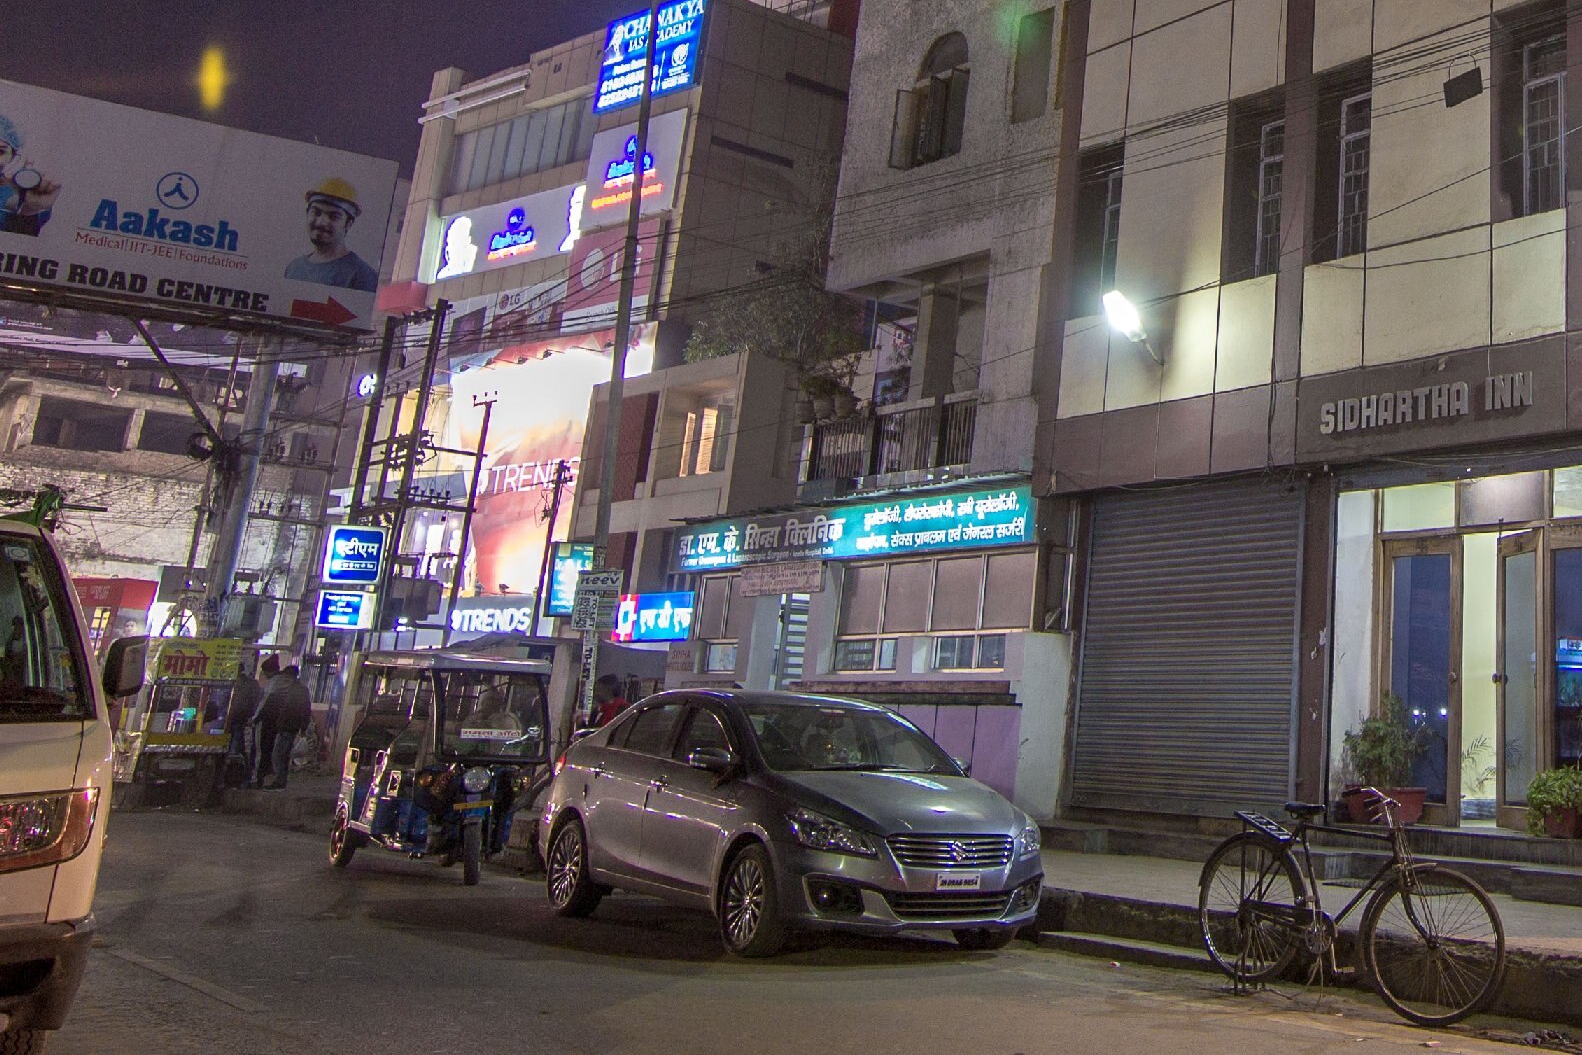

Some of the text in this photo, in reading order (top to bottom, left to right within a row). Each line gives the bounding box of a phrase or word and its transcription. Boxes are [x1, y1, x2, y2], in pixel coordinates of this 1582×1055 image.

[628, 35, 645, 52] IAS
[89, 198, 240, 252] Aakash
[179, 249, 248, 271] Foundations
[67, 262, 148, 294] ROAD
[156, 278, 269, 312] CENTRE
[1319, 370, 1534, 435] SIDHARTHA INN
[491, 457, 582, 495] TRENDS
[580, 574, 620, 585] neev
[462, 607, 532, 632] TRENDS
[163, 649, 210, 676] मोमो
